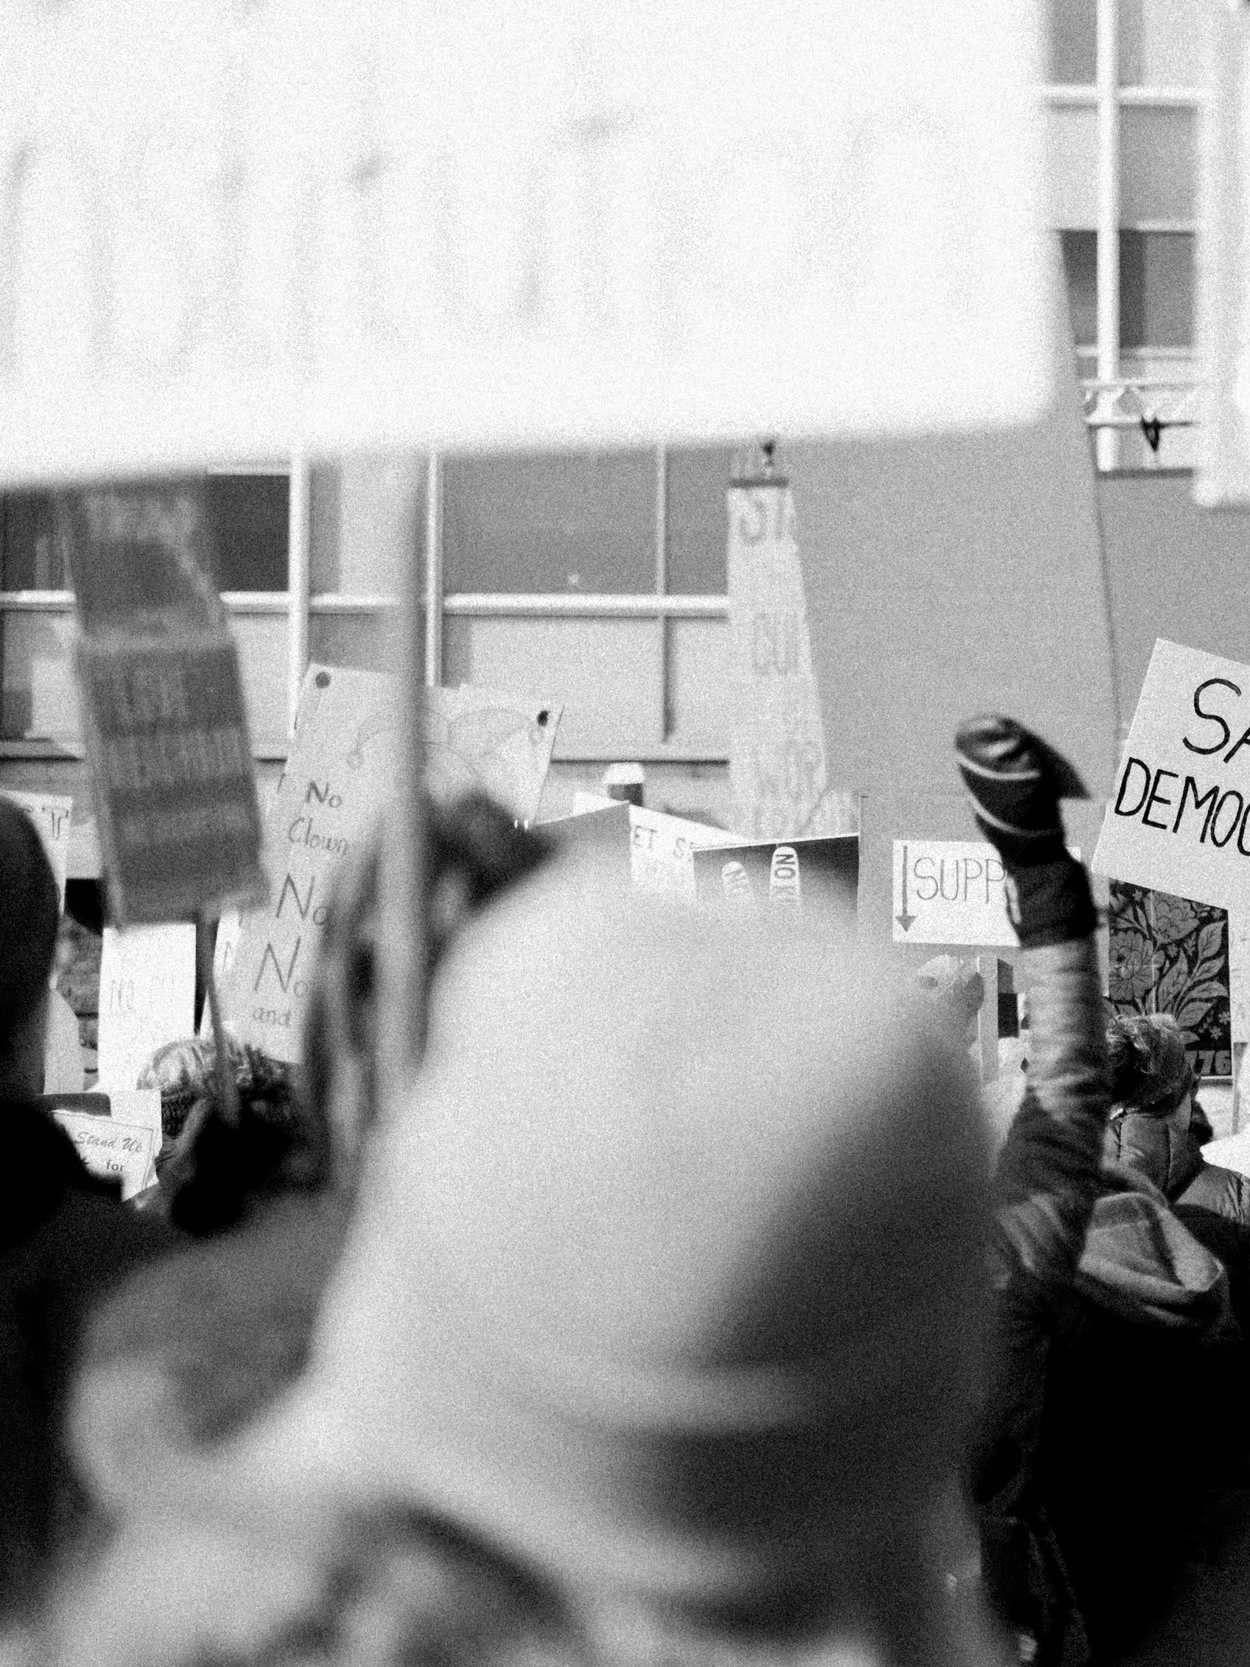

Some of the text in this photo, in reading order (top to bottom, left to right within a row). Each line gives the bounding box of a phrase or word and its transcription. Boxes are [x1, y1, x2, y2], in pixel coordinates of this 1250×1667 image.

[305, 780, 343, 808] No
[275, 872, 328, 926] No
[253, 936, 307, 998] No
[251, 1006, 292, 1028] and
[105, 1159, 125, 1172] for
